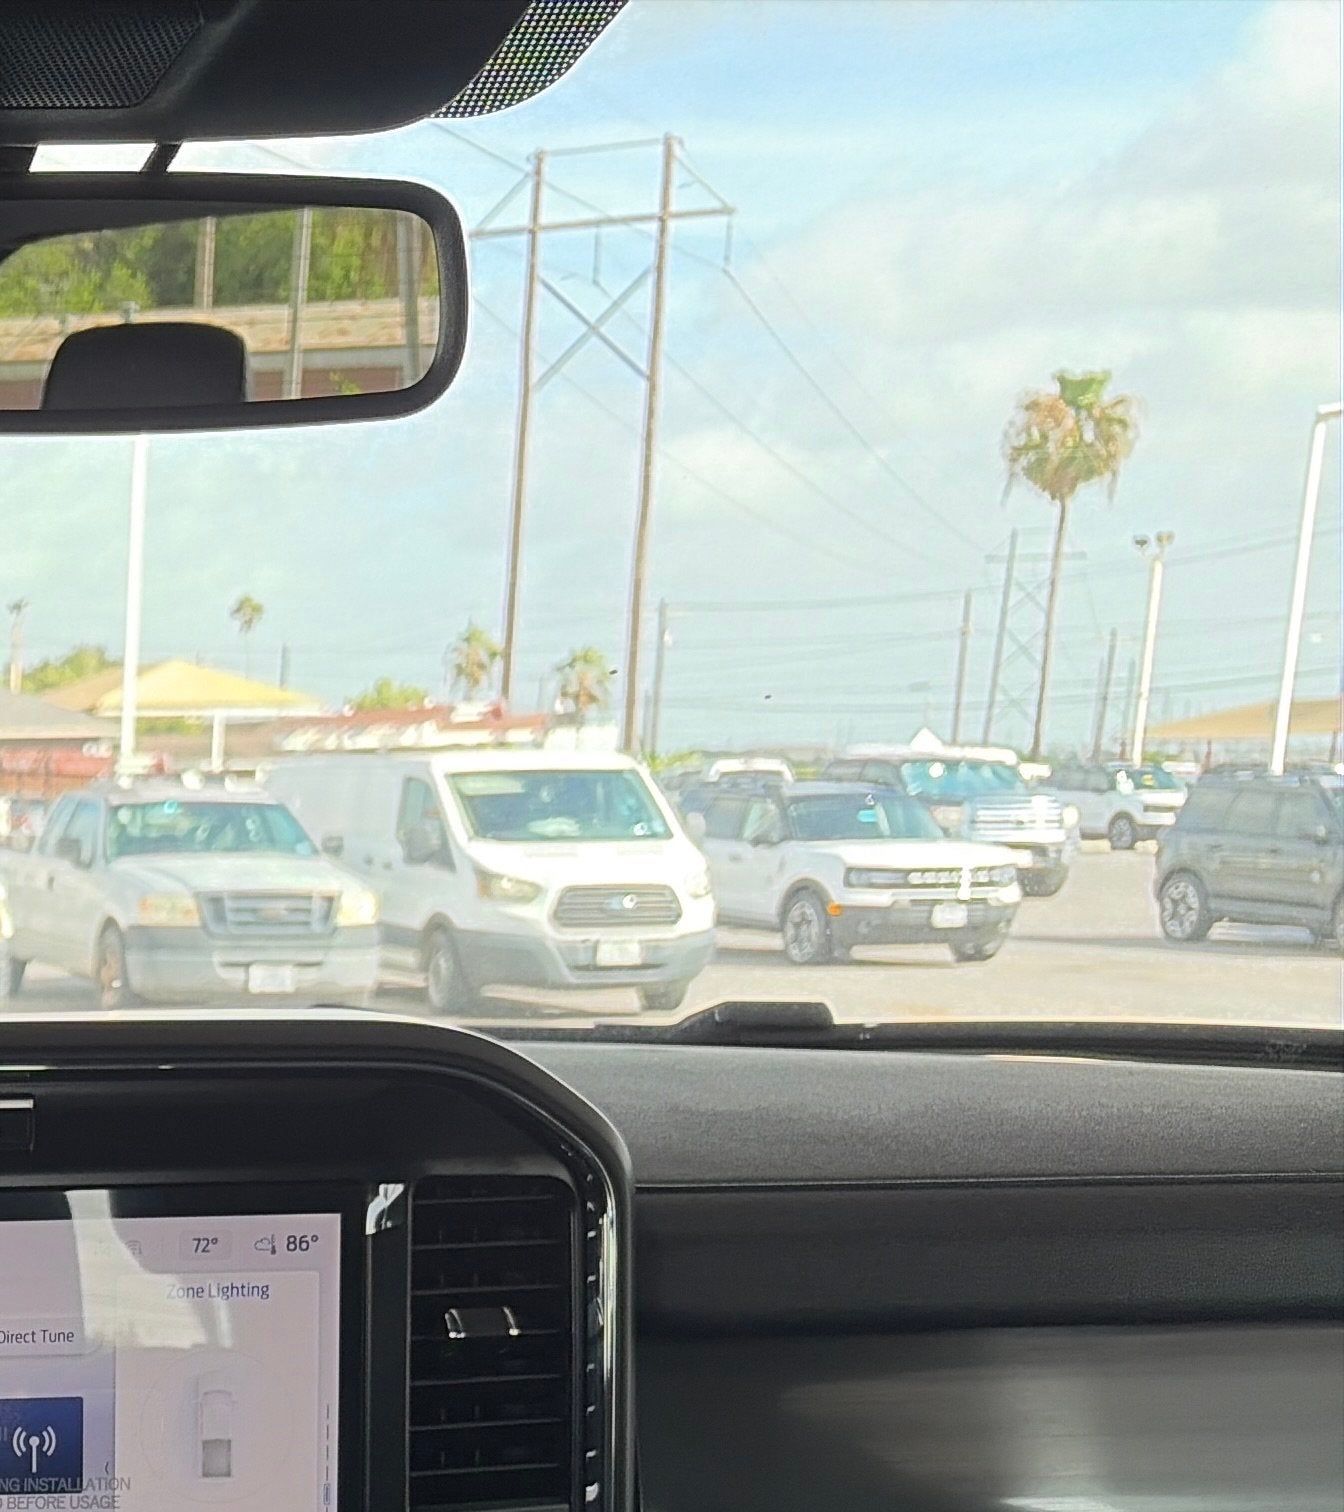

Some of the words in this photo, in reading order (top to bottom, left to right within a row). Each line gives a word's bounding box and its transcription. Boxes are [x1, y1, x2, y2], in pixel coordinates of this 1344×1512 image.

[166, 1284, 205, 1300] Zone
[208, 1281, 270, 1300] Lighting
[40, 1329, 75, 1344] Tune
[23, 1476, 131, 1492] INSTALLATION
[6, 1496, 67, 1510] BEFORE
[69, 1495, 121, 1510] USAGE
